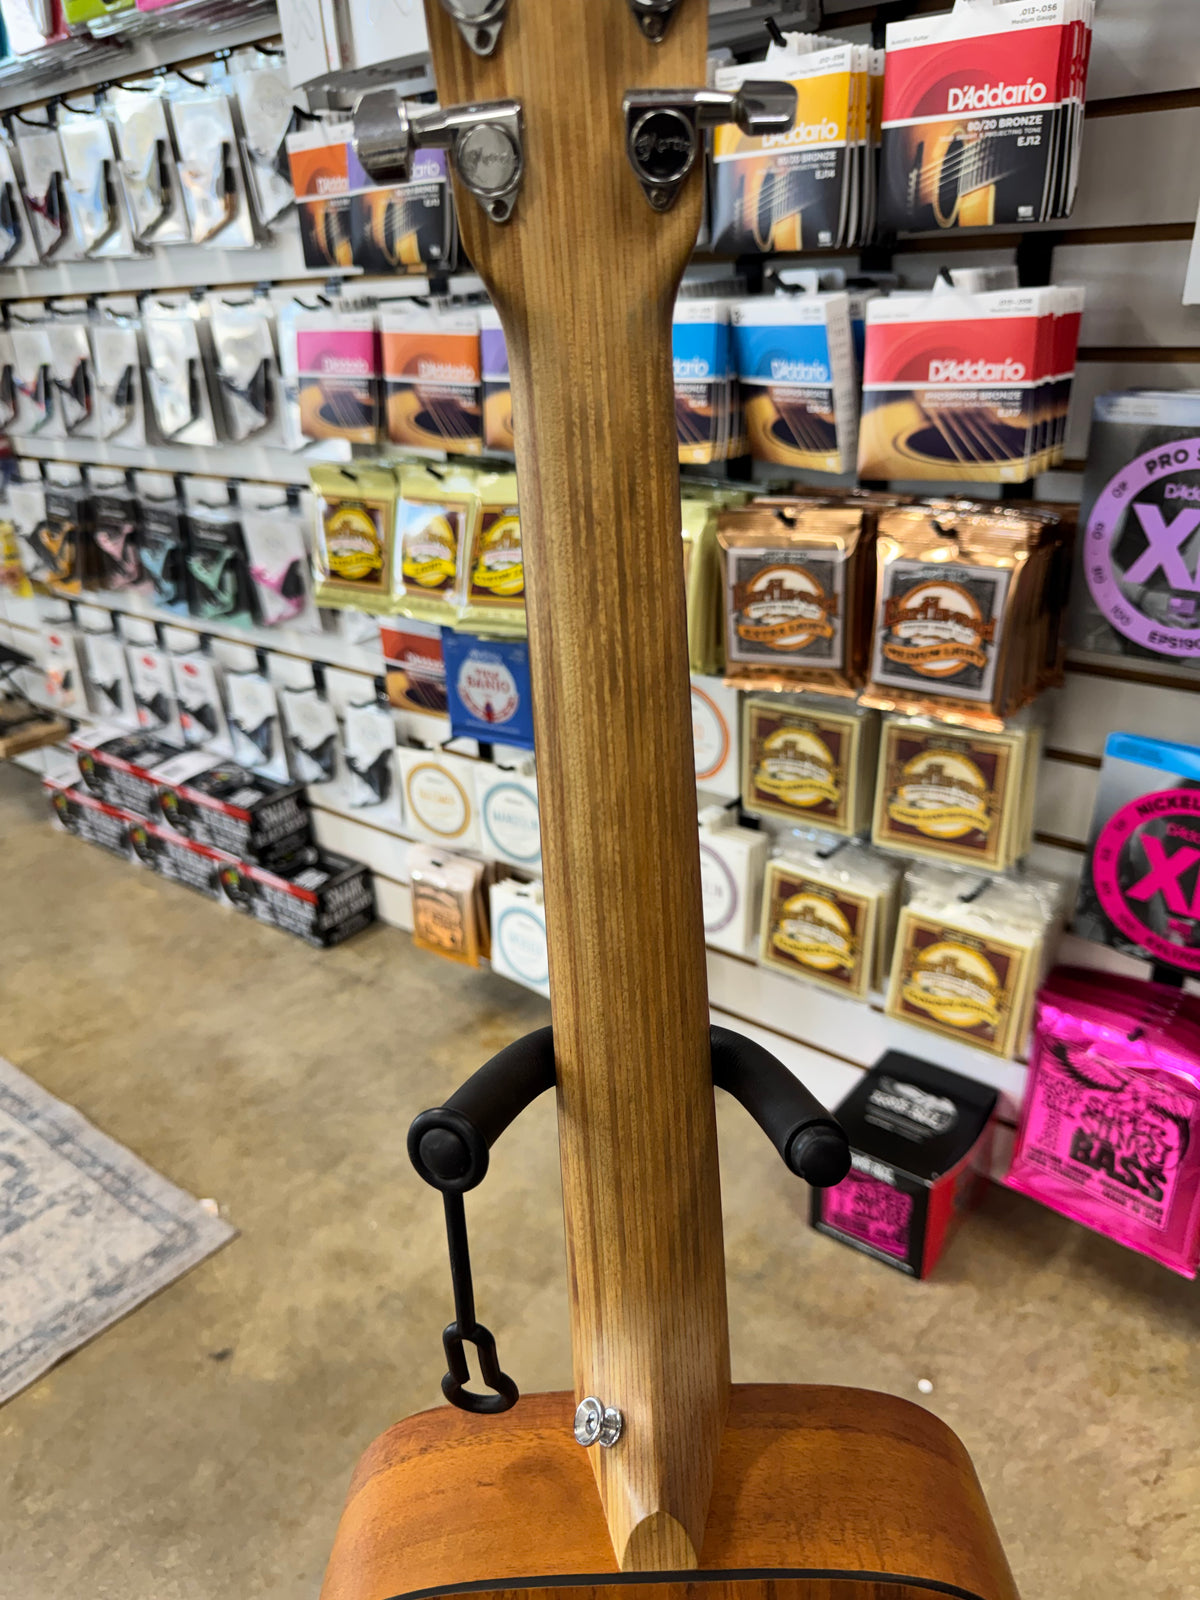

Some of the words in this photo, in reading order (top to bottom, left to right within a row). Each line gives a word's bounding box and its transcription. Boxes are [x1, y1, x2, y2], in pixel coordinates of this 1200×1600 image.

[947, 77, 1047, 112] D'Addario
[762, 117, 839, 148] DAddario
[998, 114, 1044, 129] BRONZE
[1017, 135, 1042, 147] EJ12
[928, 357, 1026, 382] D'Addario
[1144, 448, 1189, 476] PRO
[1070, 1126, 1167, 1203] BASS
